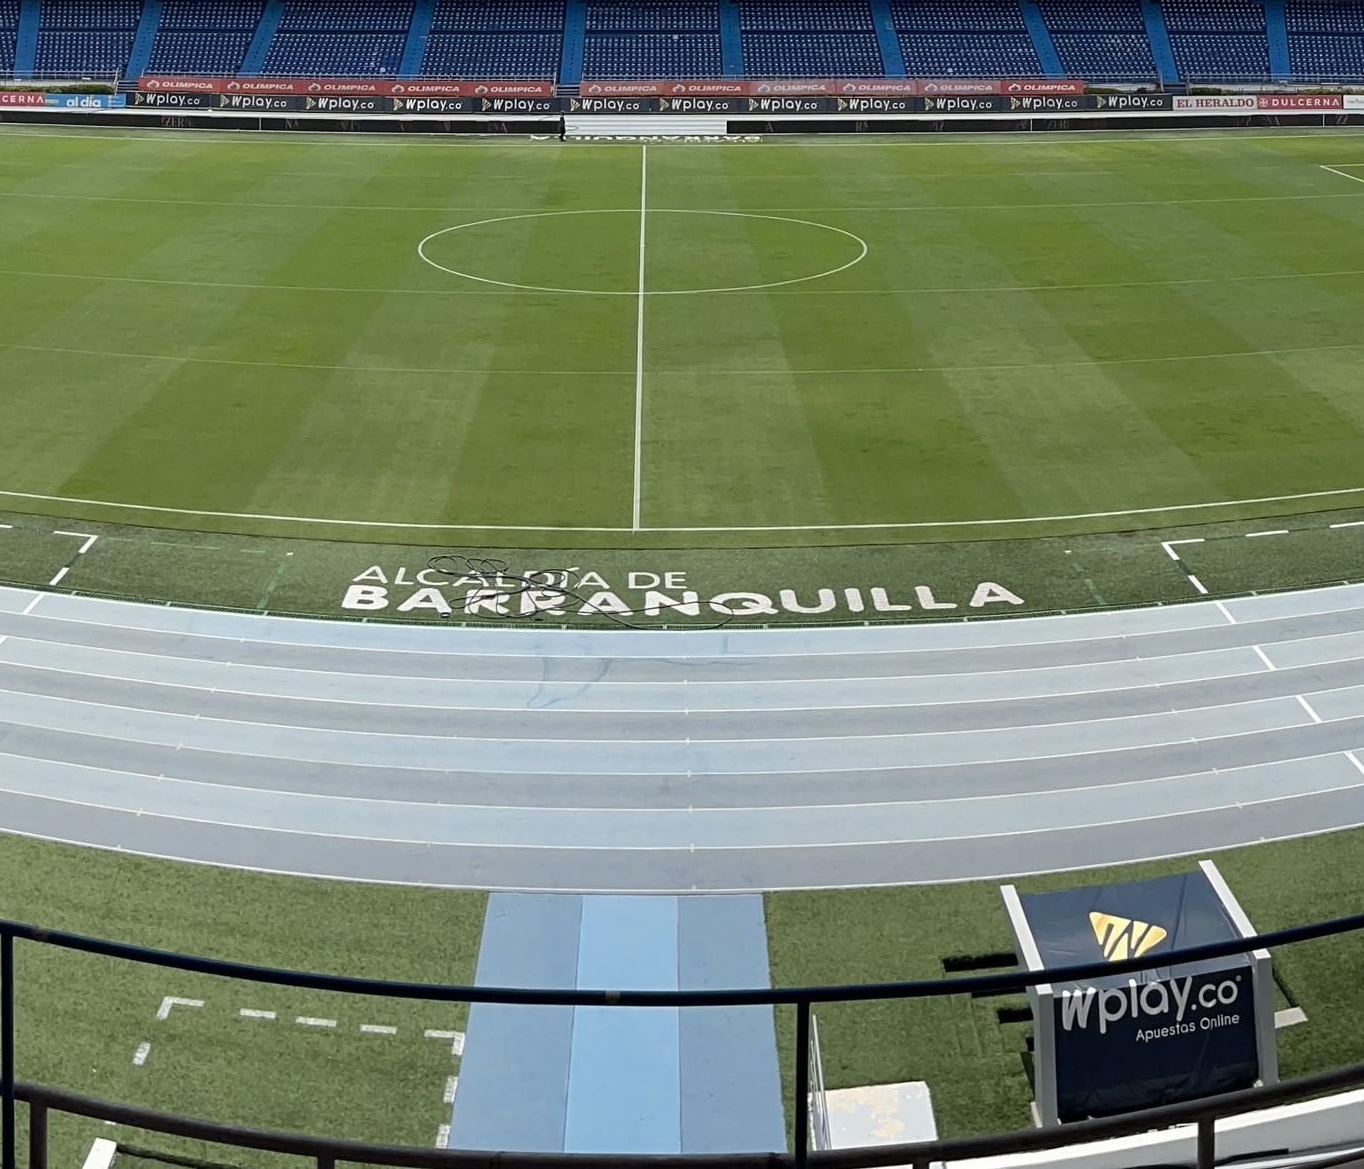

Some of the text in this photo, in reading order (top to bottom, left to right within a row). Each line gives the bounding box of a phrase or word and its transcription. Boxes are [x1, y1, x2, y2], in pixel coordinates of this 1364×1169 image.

[162, 82, 214, 90] OLIMPICA
[242, 83, 294, 91] OLIMPICA
[324, 84, 376, 92] OLIMPICA
[408, 85, 460, 93] OLIMPICA
[604, 85, 657, 93] OLIMPICA
[772, 84, 827, 92] OLIMPICA
[857, 84, 912, 92] OLIMPICA
[944, 84, 998, 92] OLIMPICA
[1023, 83, 1078, 92] OLIMPICA
[1176, 98, 1254, 108] EL HERALDO
[1272, 98, 1340, 107] DULCERNA
[628, 571, 687, 589] DE
[341, 581, 1024, 616] BARRANQUILLA
[1200, 1012, 1240, 1030] Online
